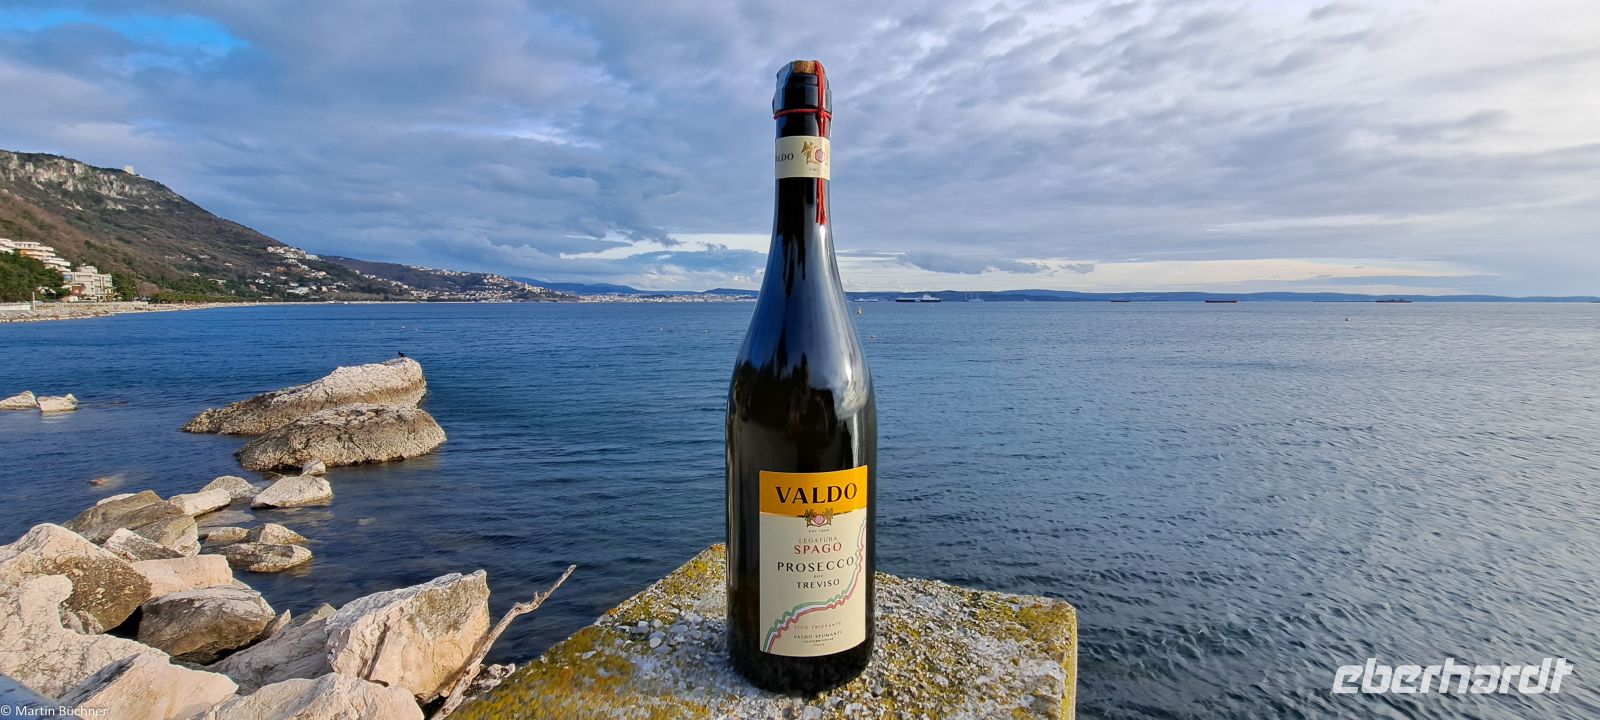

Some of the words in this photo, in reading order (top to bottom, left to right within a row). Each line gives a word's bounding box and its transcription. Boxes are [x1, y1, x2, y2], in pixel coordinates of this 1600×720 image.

[775, 482, 858, 504] VALDO
[794, 542, 842, 555] SPAGO
[777, 556, 854, 572] PROSECCO
[796, 579, 840, 589] TREVISO
